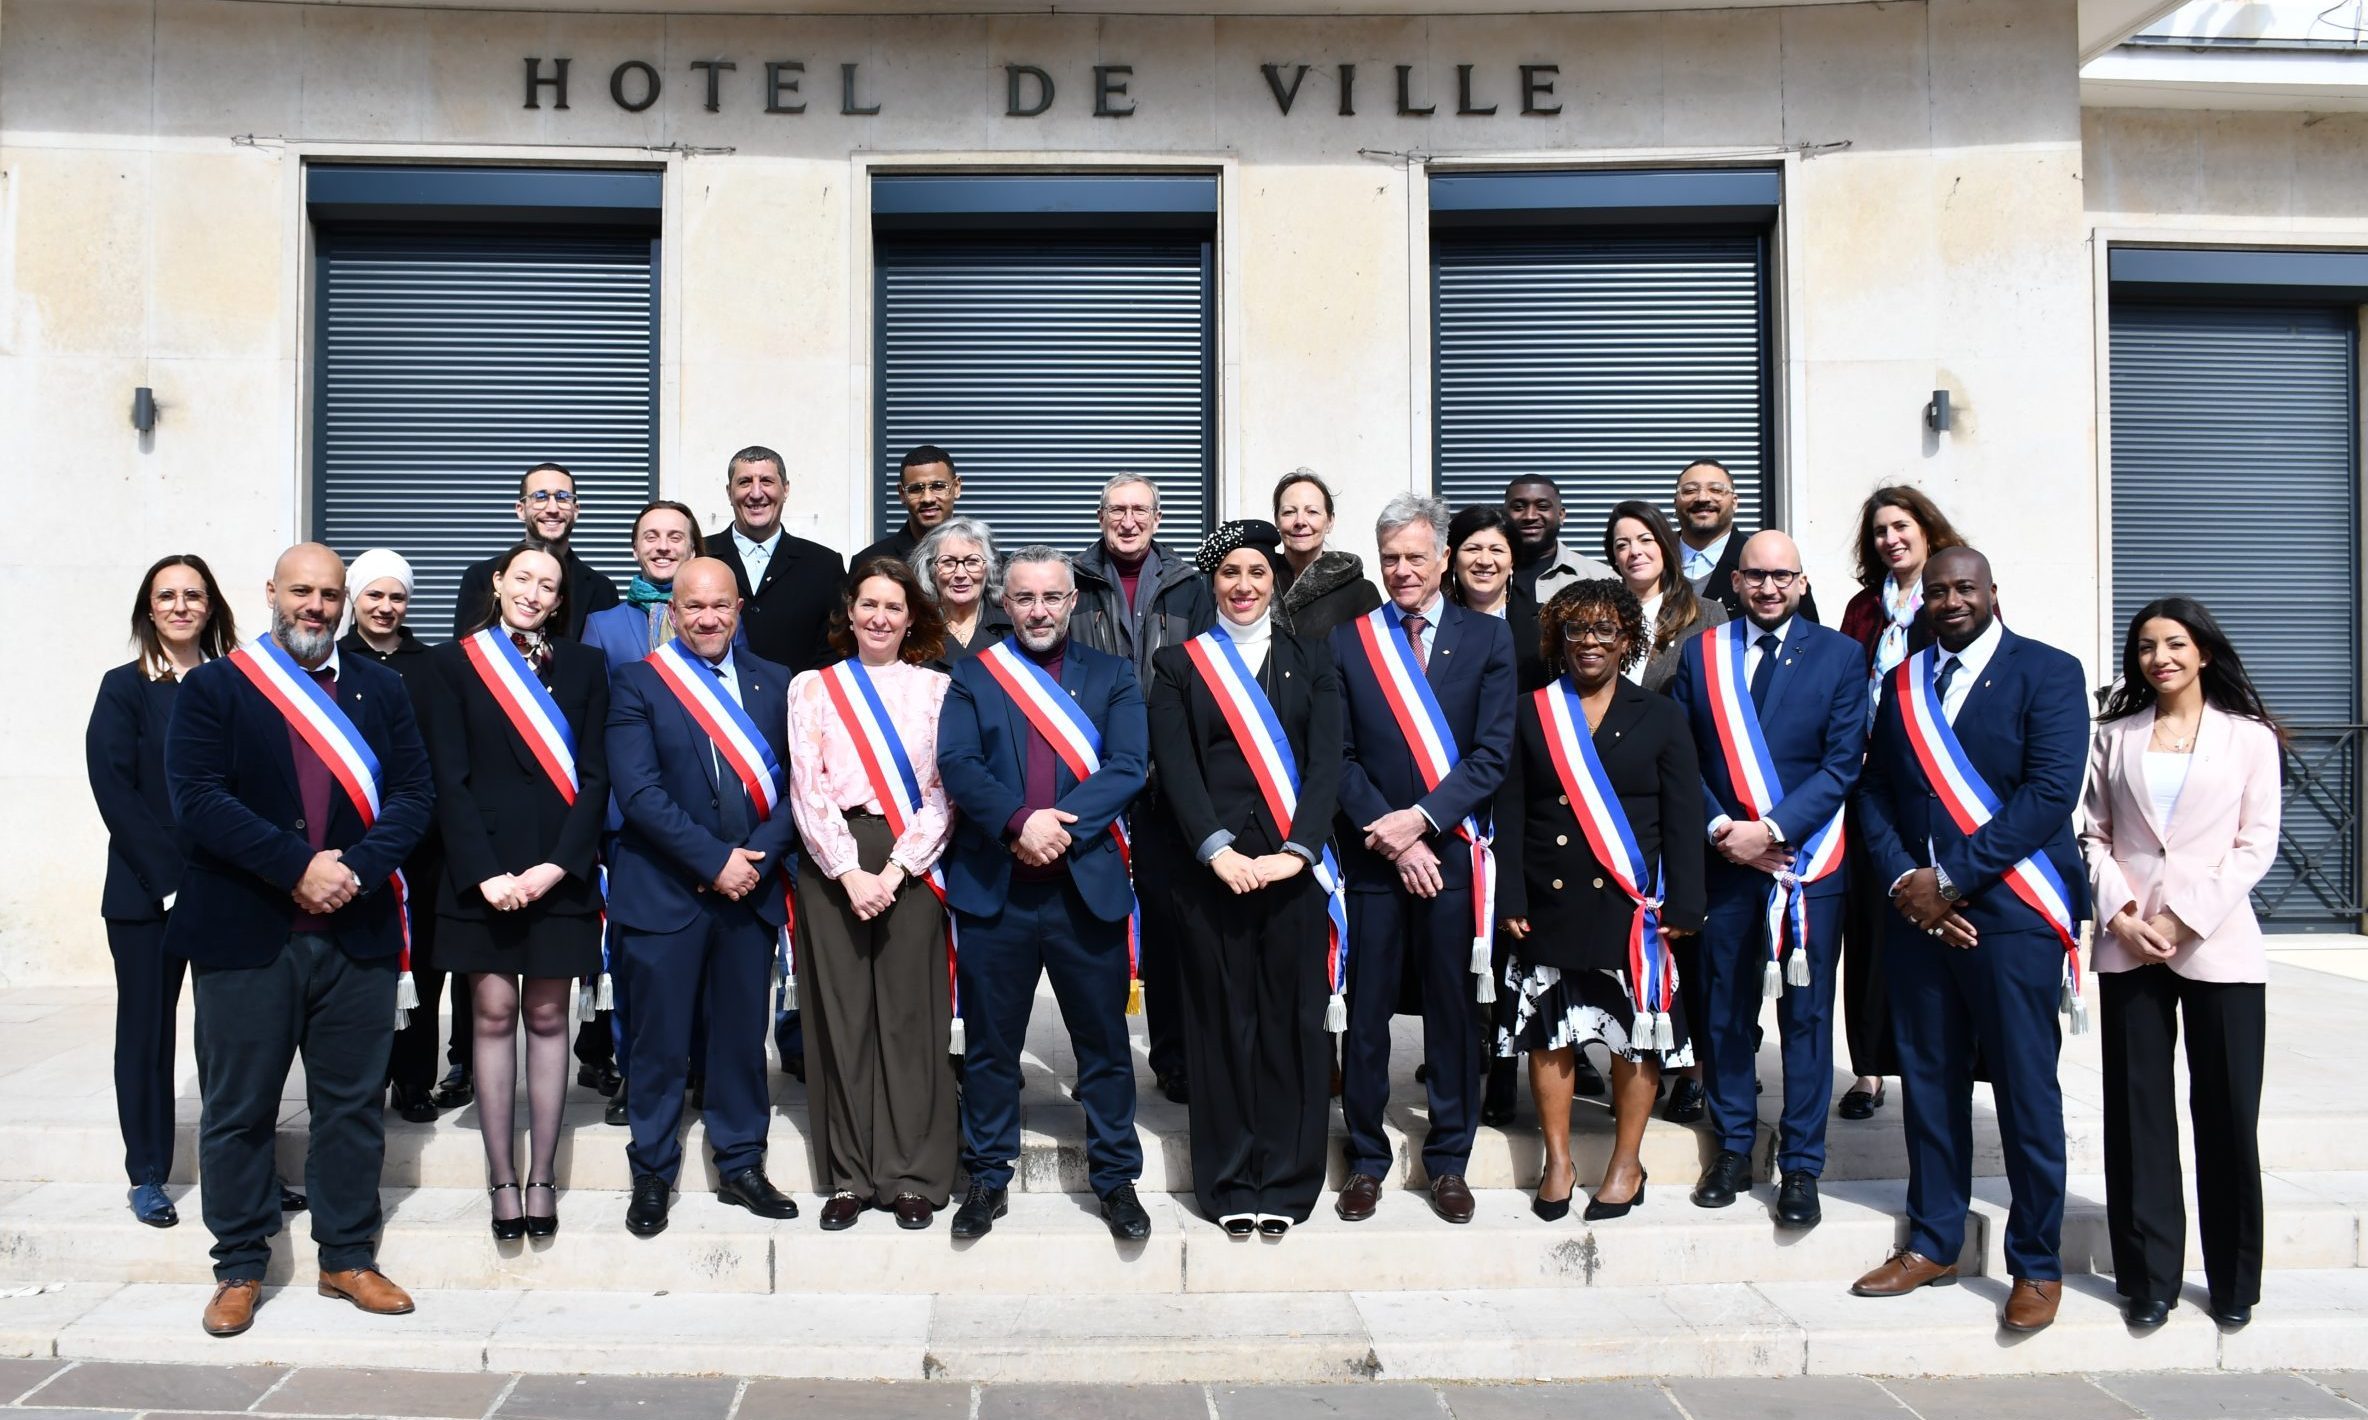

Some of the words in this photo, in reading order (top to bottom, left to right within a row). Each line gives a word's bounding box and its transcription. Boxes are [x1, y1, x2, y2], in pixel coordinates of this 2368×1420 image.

[523, 57, 881, 115] HOTEL
[1003, 62, 1136, 118] DE
[1259, 62, 1563, 118] VILLE
